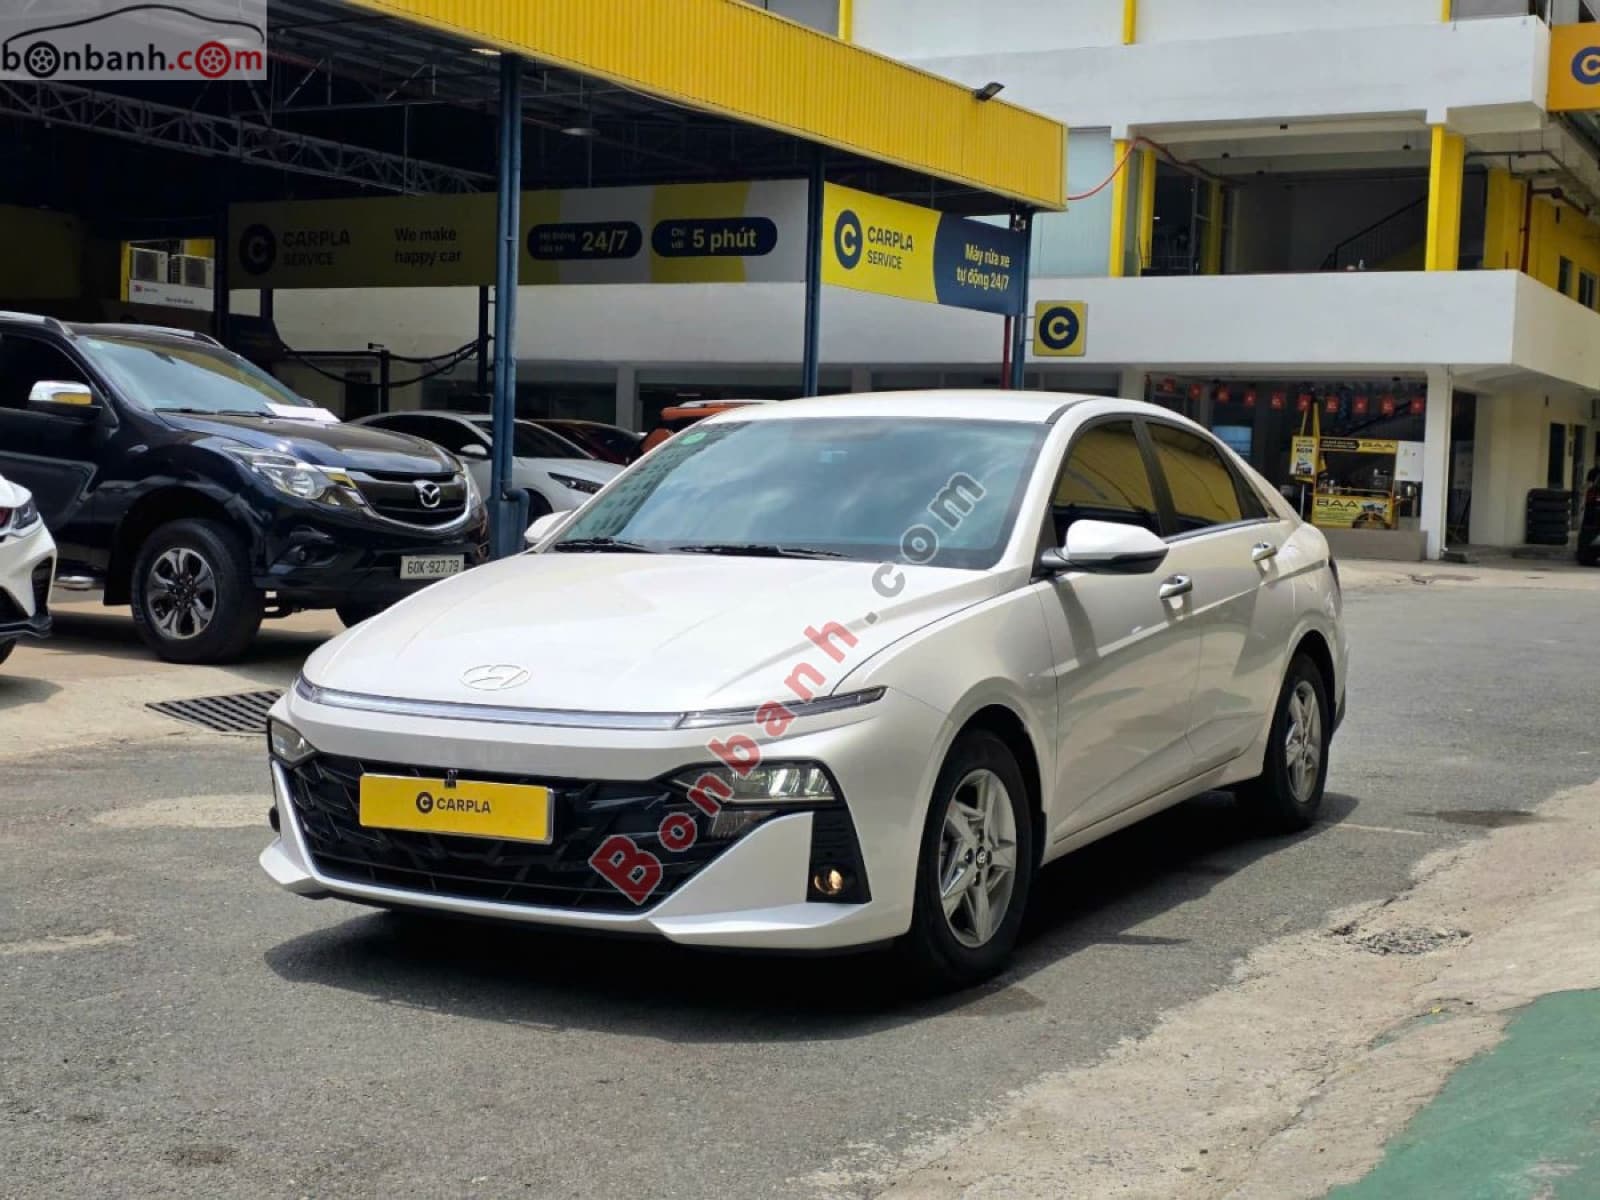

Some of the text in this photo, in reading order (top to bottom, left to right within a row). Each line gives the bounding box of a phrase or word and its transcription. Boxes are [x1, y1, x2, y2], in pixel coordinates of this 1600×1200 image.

[282, 229, 351, 248] CARPLA
[394, 226, 457, 242] We make
[581, 229, 629, 254] 24/7
[692, 226, 758, 254] 5 phút
[867, 226, 914, 252] CARPLA
[283, 252, 336, 267] SERVICE
[394, 250, 463, 267] happy car
[867, 250, 902, 270] SERVICE
[964, 243, 984, 266] Máy
[1000, 254, 1011, 269] xe
[967, 267, 989, 291] động
[990, 271, 1009, 292] 24/7
[1316, 497, 1359, 508] BAA
[436, 797, 491, 814] CARPLA
